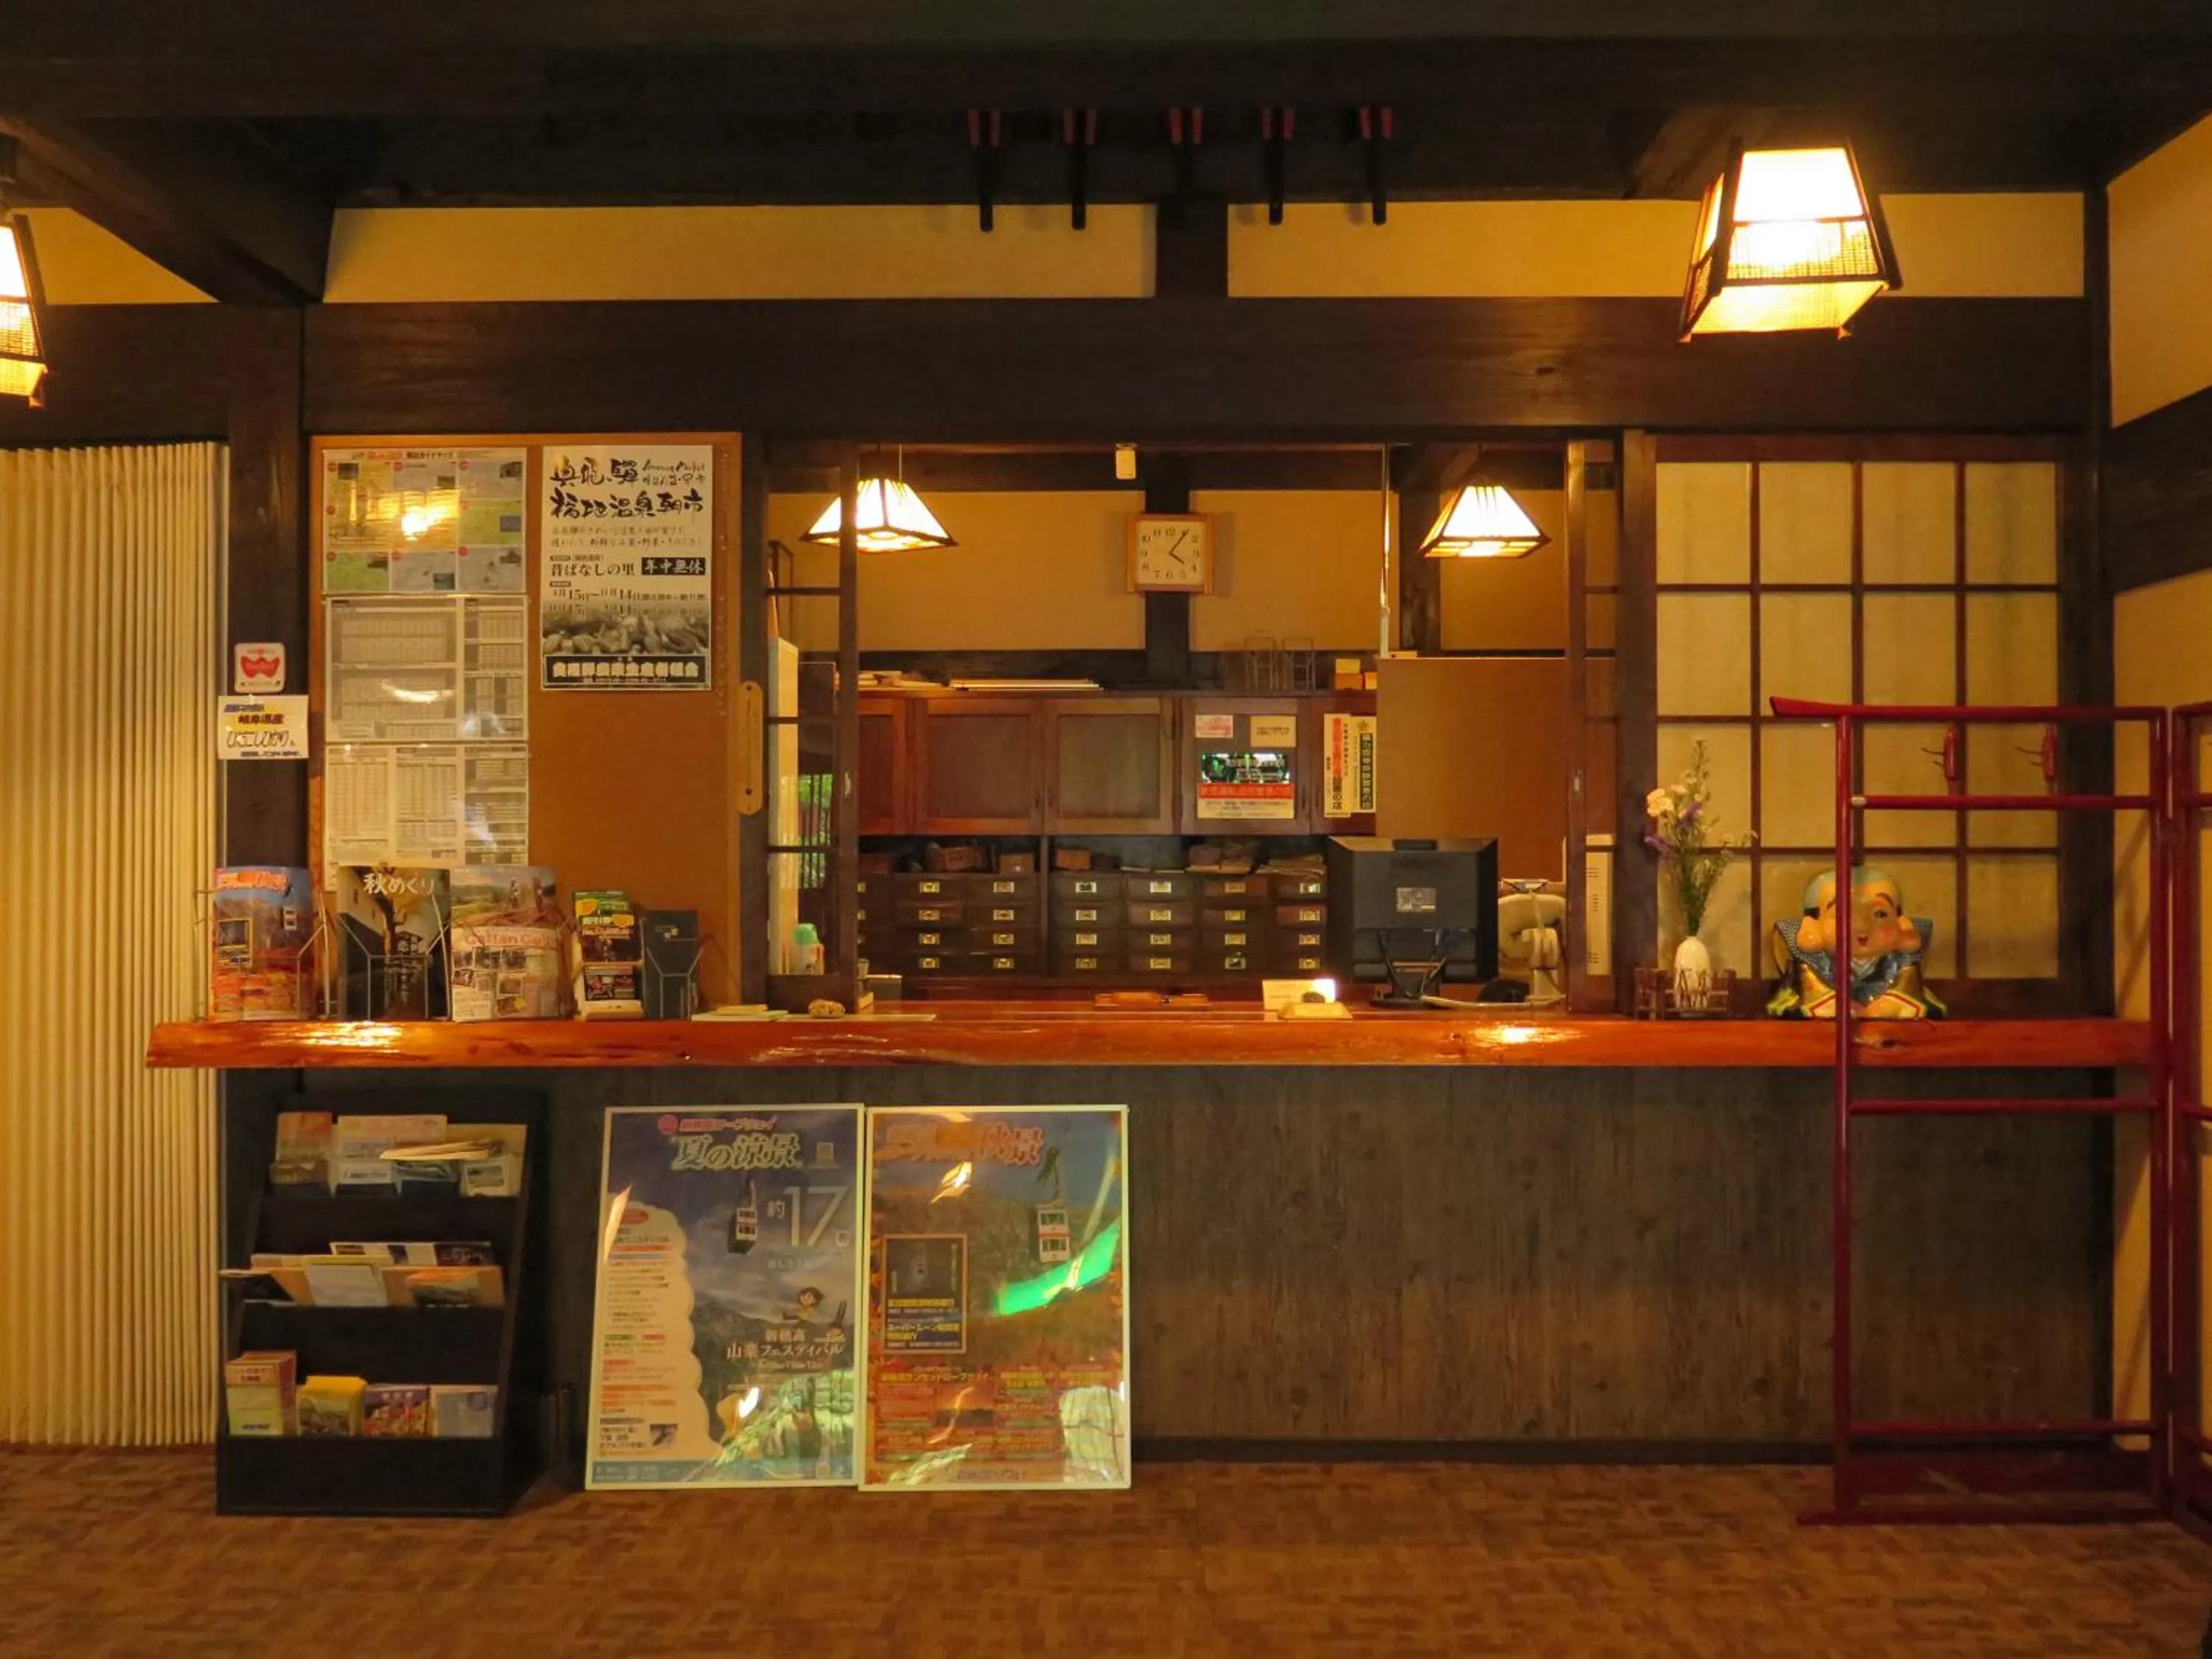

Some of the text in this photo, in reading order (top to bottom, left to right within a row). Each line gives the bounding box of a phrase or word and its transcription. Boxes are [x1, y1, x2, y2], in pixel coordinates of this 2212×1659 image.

[550, 487, 703, 518] 福地温泉朝市
[552, 563, 635, 577] 昔ばなしの里
[644, 558, 704, 575] 年中無休
